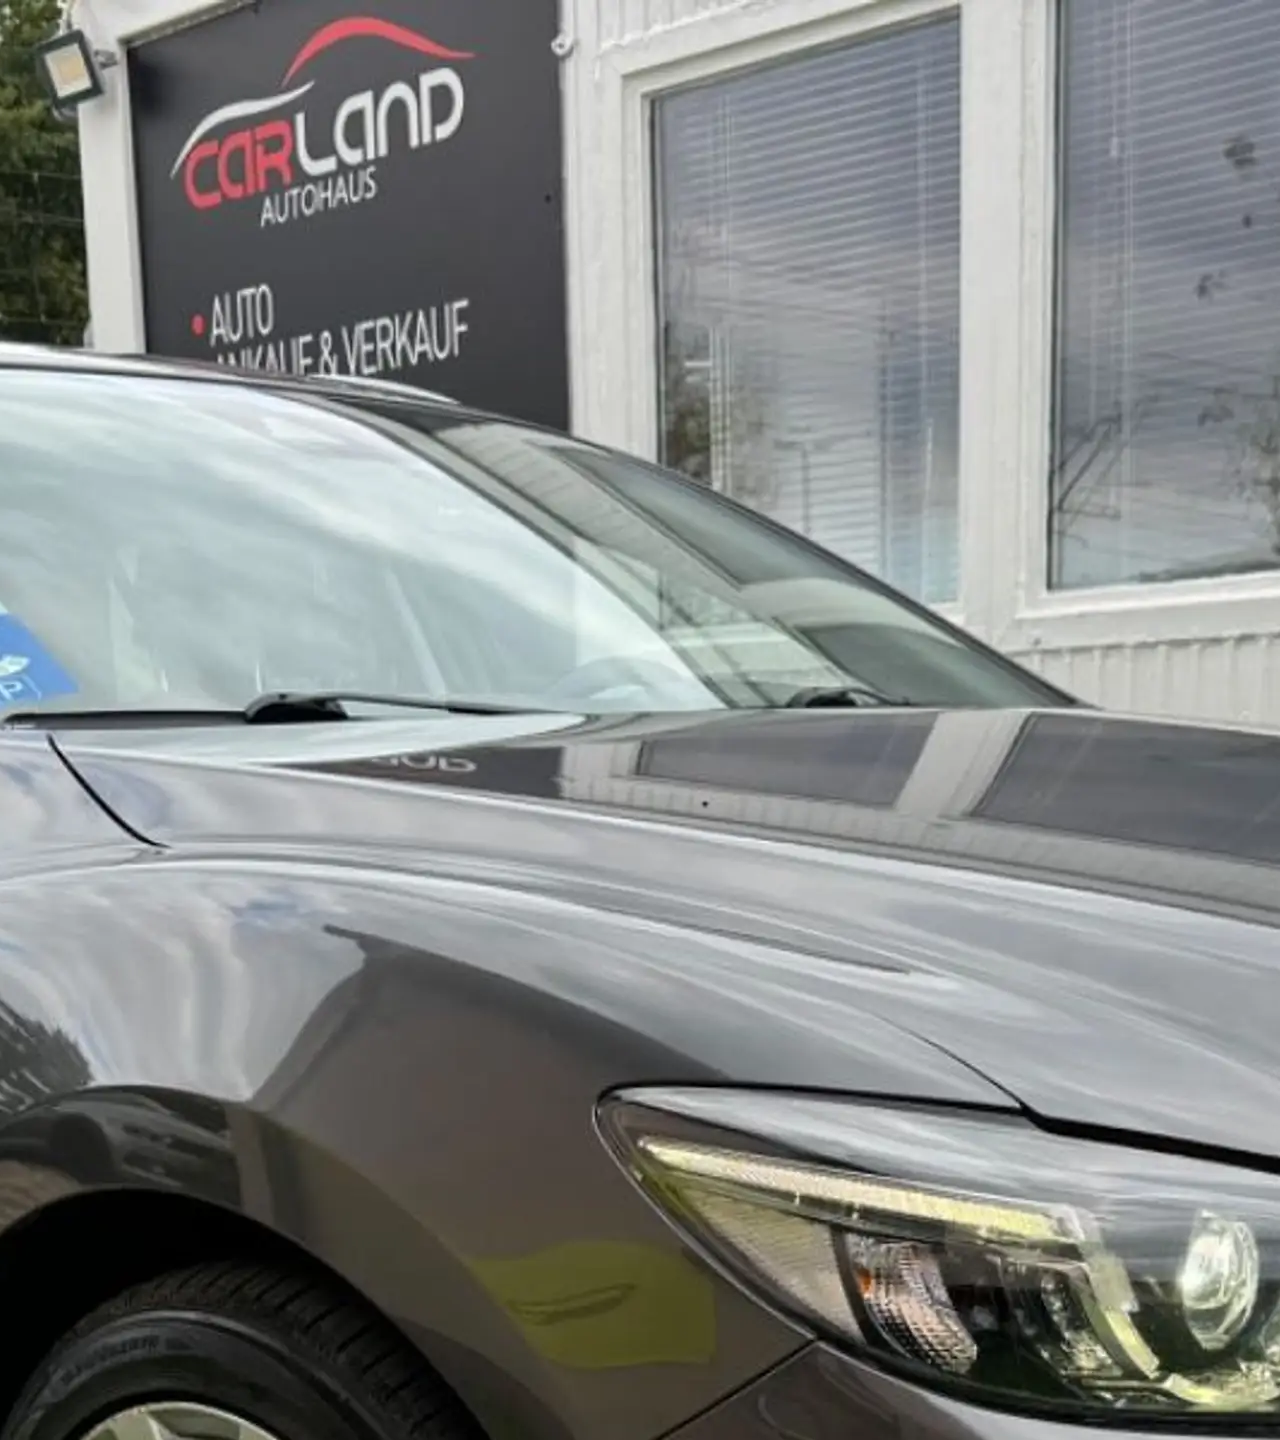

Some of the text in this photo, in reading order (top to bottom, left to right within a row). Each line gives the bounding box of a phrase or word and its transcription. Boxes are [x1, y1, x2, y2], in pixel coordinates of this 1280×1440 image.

[260, 165, 377, 228] AUTOHAUS
[210, 283, 273, 347] AUTO
[318, 330, 338, 376] &
[341, 298, 469, 377] VERKAUF
